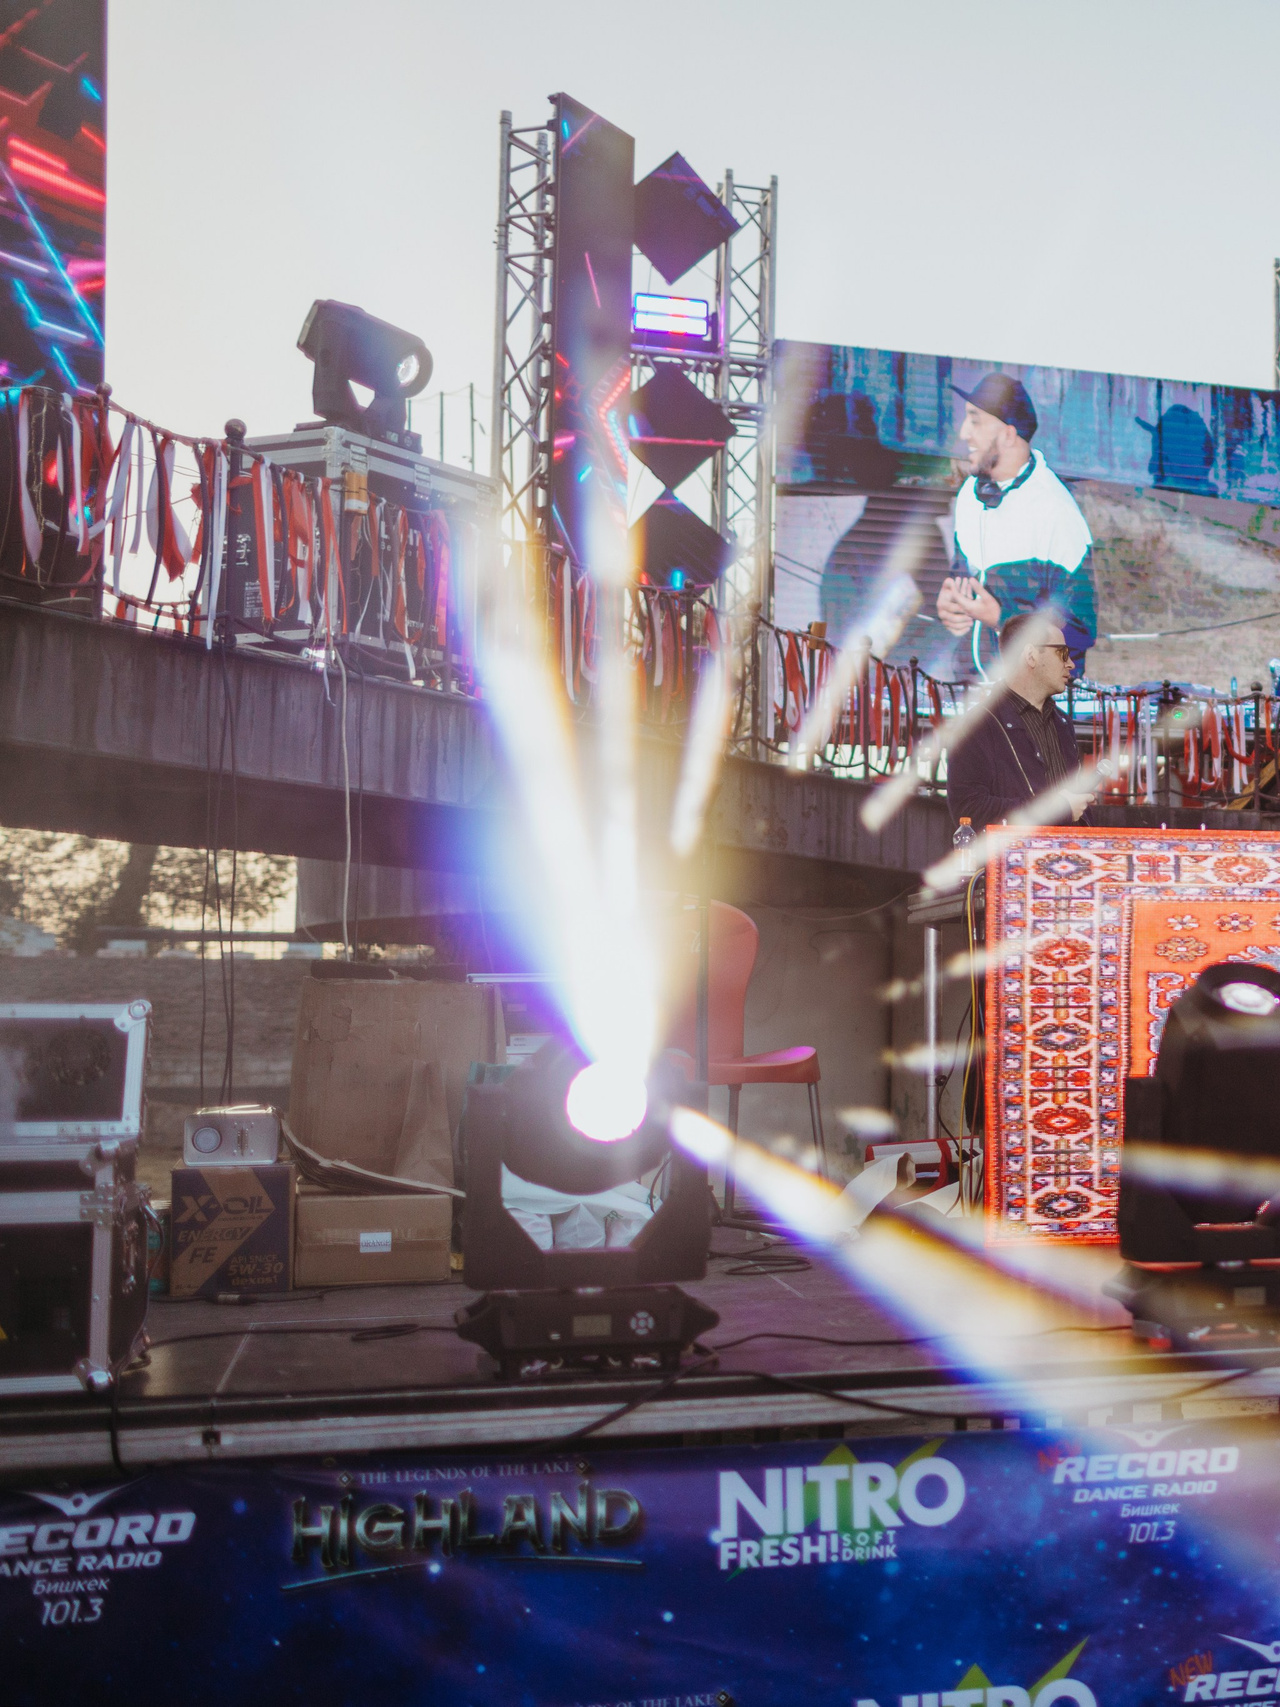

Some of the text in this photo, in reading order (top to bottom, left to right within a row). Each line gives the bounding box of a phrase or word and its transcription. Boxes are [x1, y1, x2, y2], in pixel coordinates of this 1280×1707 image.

[174, 1195, 275, 1223] X-OIL
[177, 1226, 254, 1243] ENERGY
[189, 1246, 218, 1264] FE
[227, 1262, 284, 1276] 5W-30
[359, 1461, 574, 1485] THE LEGENDS OF THE LAKE
[1053, 1446, 1239, 1485] RECORD
[719, 1457, 966, 1540] NITRO
[1073, 1480, 1218, 1503] DANCE RADIO
[1120, 1503, 1181, 1518] Бишкек
[0, 1512, 196, 1557] ECORD
[291, 1480, 640, 1568] HIGHLAND
[1128, 1520, 1176, 1544] 101.3
[842, 1530, 897, 1547] SOFT
[0, 1550, 163, 1577] ANCE RADIO
[720, 1533, 839, 1571] FRESH!
[842, 1544, 898, 1562] DRINK
[33, 1577, 110, 1596] Бишкек
[41, 1598, 104, 1626] 101.3
[1169, 1651, 1213, 1688] NEW
[674, 1694, 716, 1707] LAKE
